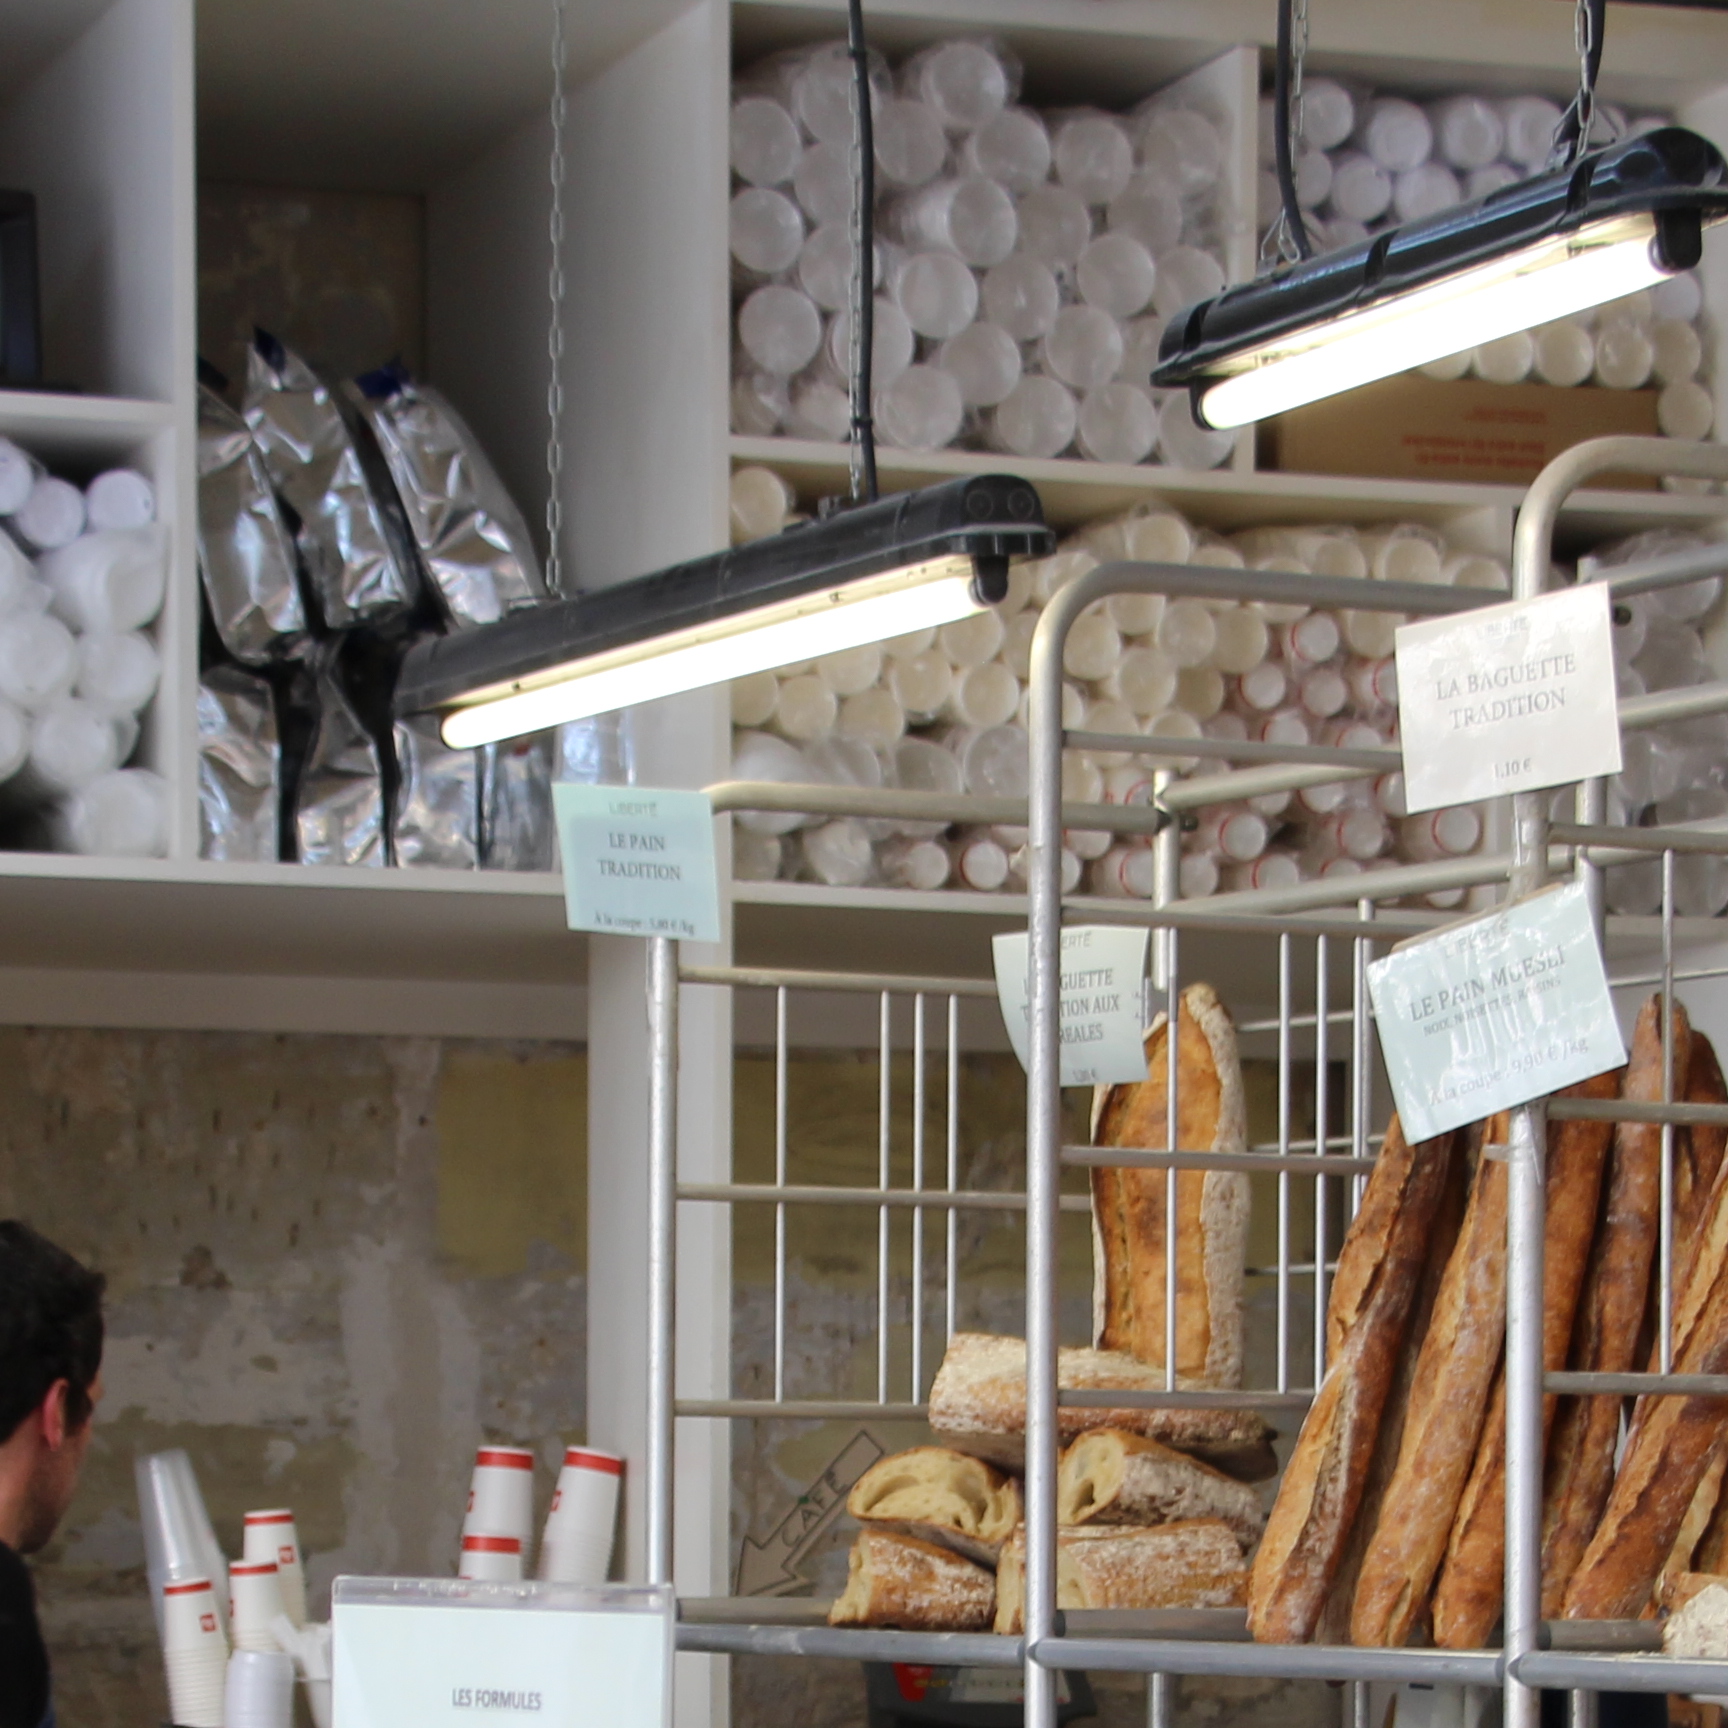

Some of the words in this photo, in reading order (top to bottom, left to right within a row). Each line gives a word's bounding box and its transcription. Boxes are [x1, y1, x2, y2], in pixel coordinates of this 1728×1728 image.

[1436, 679, 1461, 701] LA
[1467, 653, 1576, 694] BAGUETTE
[1449, 687, 1567, 730] TRADITION
[1523, 758, 1532, 771] €
[609, 833, 625, 849] LE
[630, 834, 666, 851] PAIN
[598, 859, 681, 881] TRADITION
[1410, 996, 1435, 1022] LE
[1439, 979, 1486, 1012] PAIN
[1491, 945, 1565, 988] MUESLI
[1092, 994, 1120, 1014] AUX
[1445, 1086, 1457, 1101] la
[1459, 1069, 1502, 1097] coupe
[452, 1688, 472, 1708] LES
[475, 1689, 542, 1711] FORMULES
